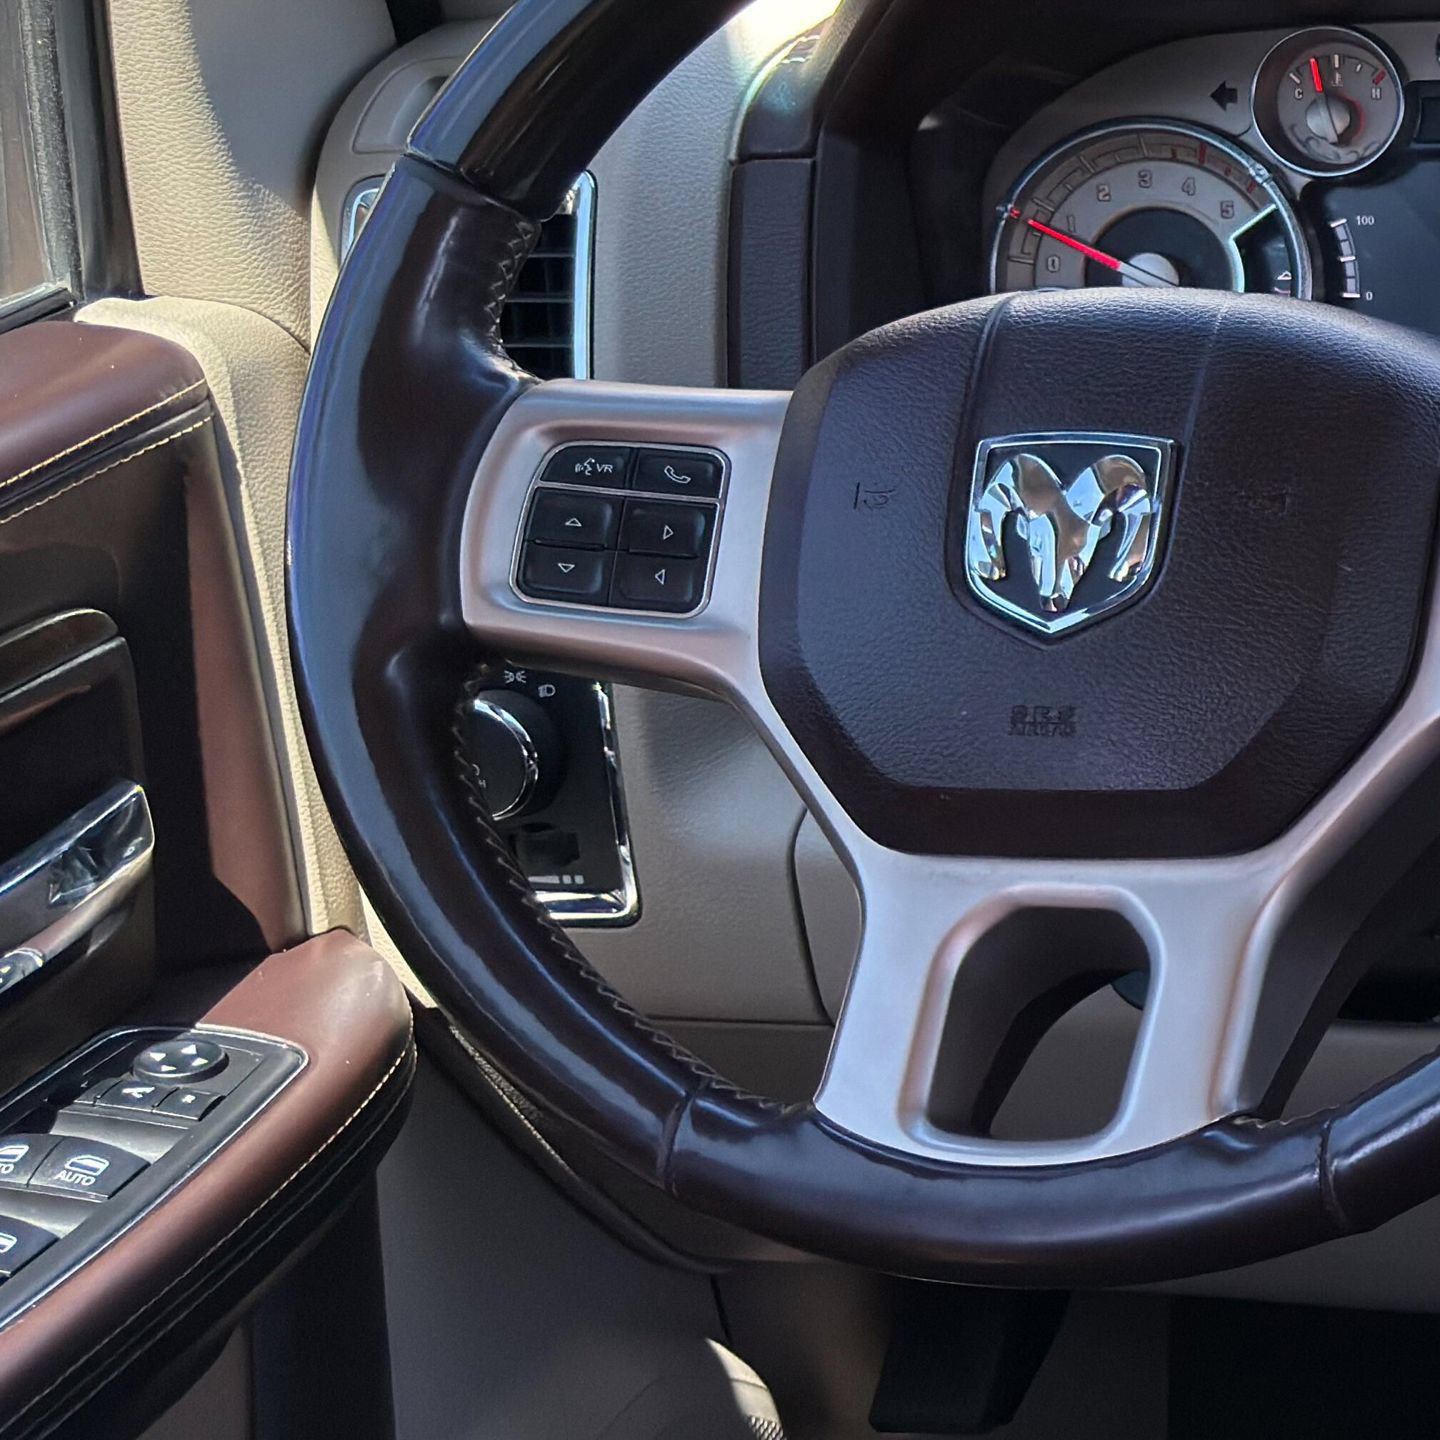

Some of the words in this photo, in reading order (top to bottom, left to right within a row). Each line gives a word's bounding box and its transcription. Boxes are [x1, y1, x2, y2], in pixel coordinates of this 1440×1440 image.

[1138, 170, 1153, 189] 3
[1182, 177, 1197, 196] 4
[1096, 184, 1112, 203] 2
[1219, 200, 1236, 219] 5
[1356, 215, 1376, 226] 100
[1047, 256, 1060, 273] 0
[1365, 291, 1374, 302] 0
[595, 463, 614, 475] VR
[55, 1168, 97, 1187] AUTO
